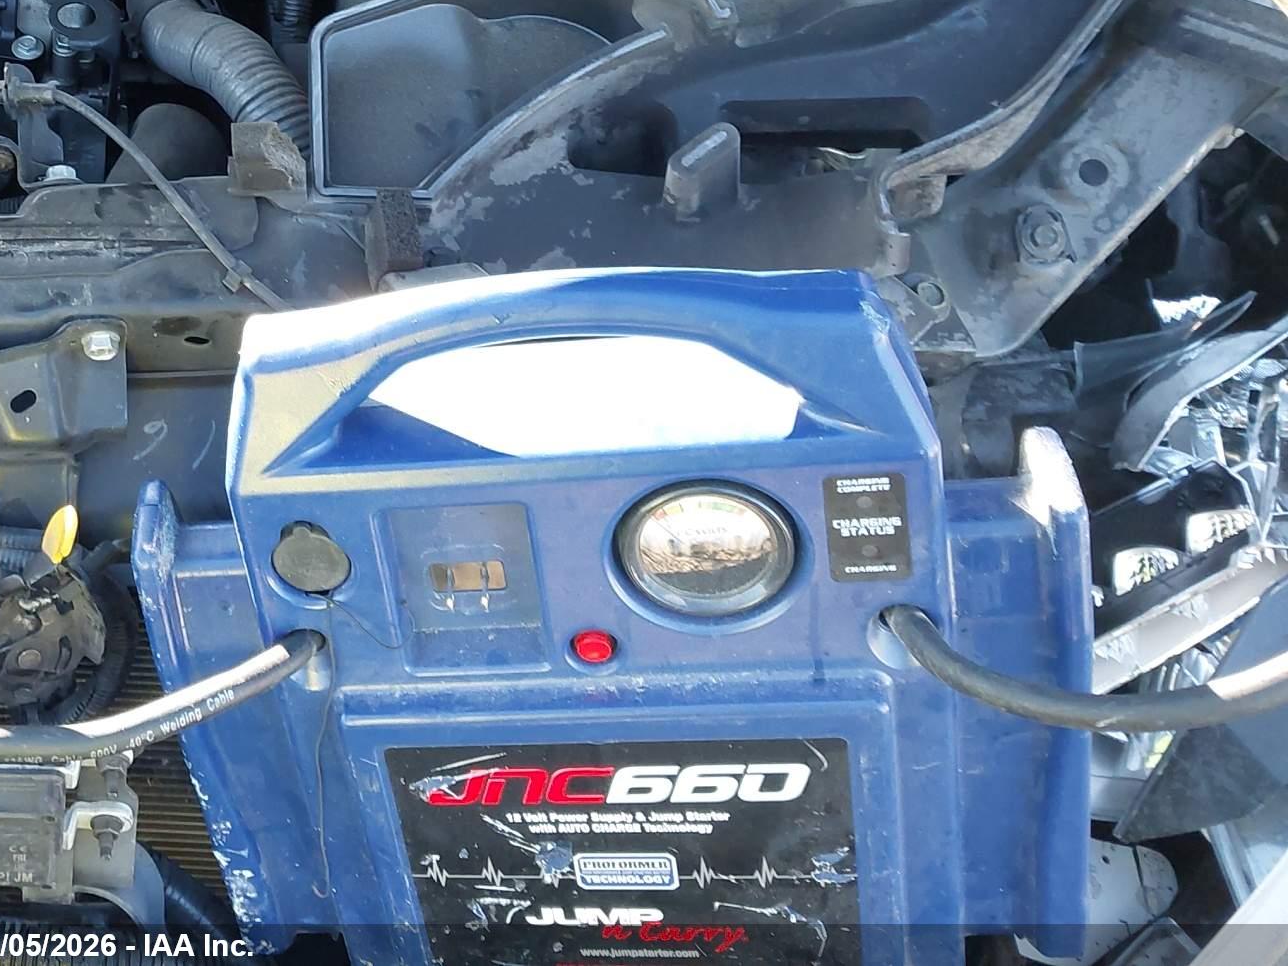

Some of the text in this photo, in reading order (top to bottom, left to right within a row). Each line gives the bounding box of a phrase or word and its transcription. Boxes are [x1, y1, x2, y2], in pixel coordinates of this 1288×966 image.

[832, 516, 902, 529] CHARGING
[840, 526, 895, 536] STATUS
[159, 707, 202, 736] Welding
[206, 688, 235, 712] Cable
[522, 811, 549, 824] Volt
[548, 811, 590, 824] Power
[590, 811, 634, 825] Supply
[634, 811, 647, 823] &
[647, 811, 685, 824] Jump
[685, 810, 732, 823] Starter
[528, 821, 714, 835] with AUTO CHARGE Technology
[582, 860, 669, 870] PROFORMER
[12, 871, 33, 883] JM
[580, 873, 672, 885] TECHNOLOGY
[525, 906, 664, 927] JUMP
[638, 920, 746, 953] Carry
[580, 945, 700, 960] www.jumpstarter.com
